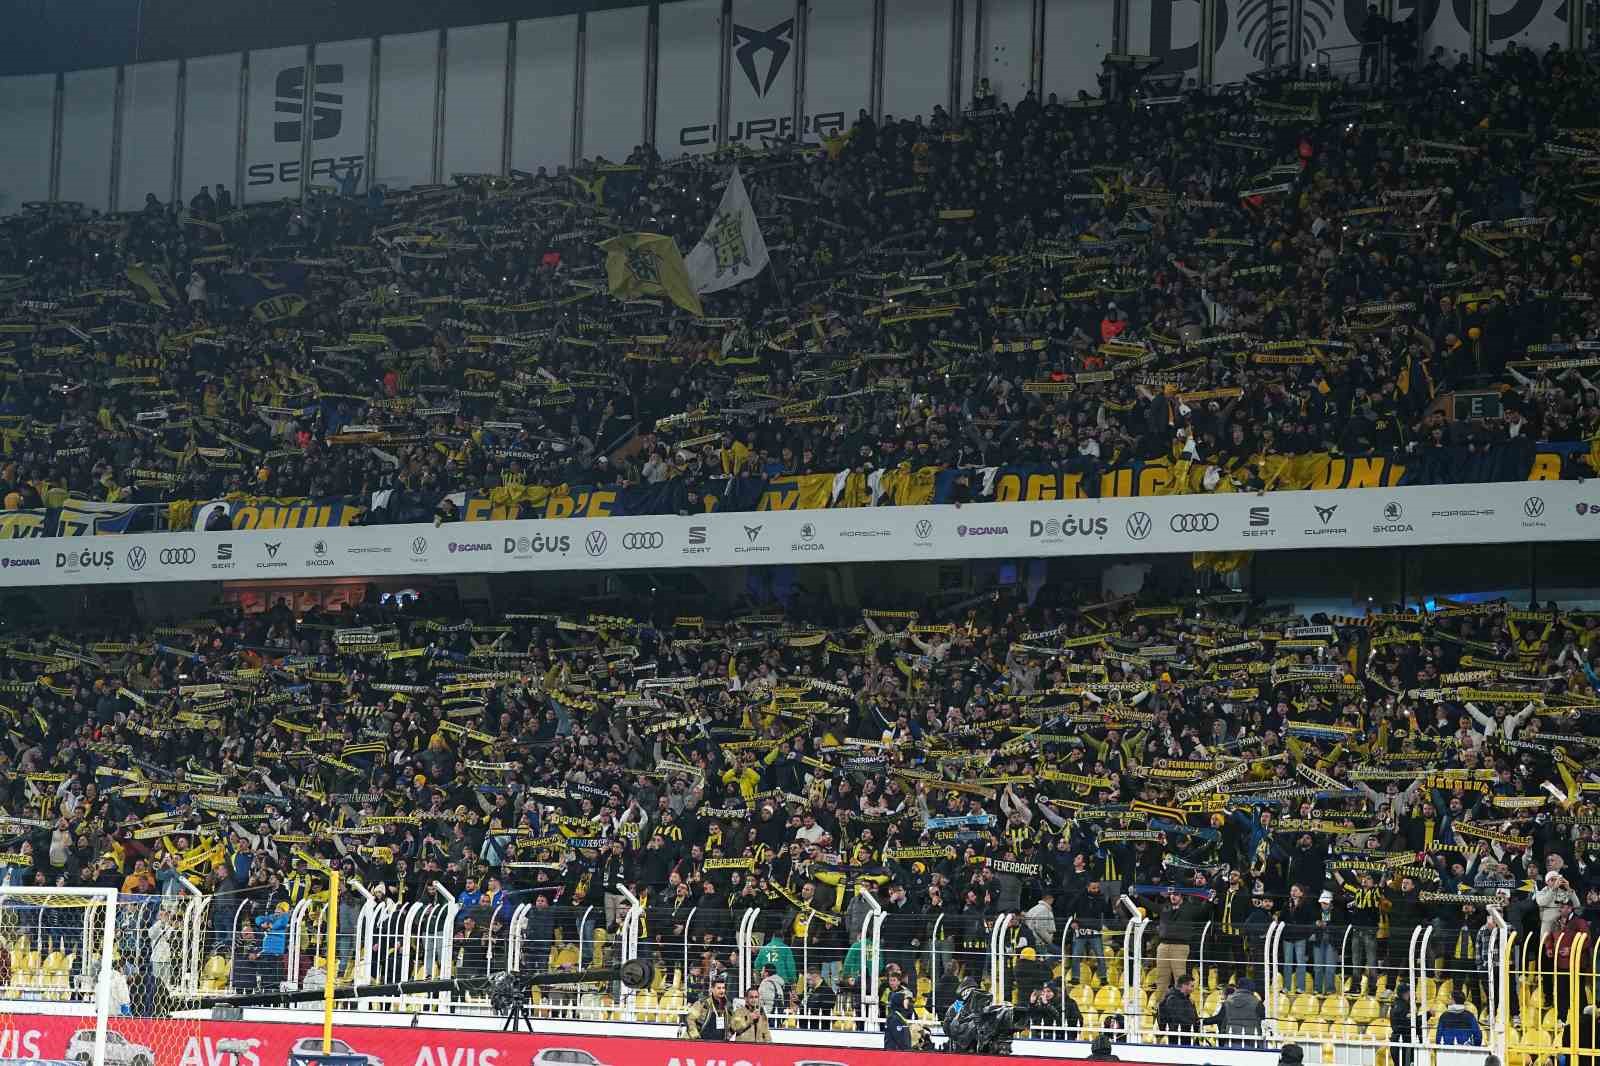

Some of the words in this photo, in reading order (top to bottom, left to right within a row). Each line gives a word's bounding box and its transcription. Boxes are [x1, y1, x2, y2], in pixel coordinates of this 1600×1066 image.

[679, 112, 844, 148] CUPRA
[246, 157, 364, 188] SEAT
[968, 526, 1009, 537] SCANIA
[1242, 529, 1277, 537] SEAT
[1304, 527, 1347, 535] CUPRA
[458, 543, 493, 553] SCANIA
[682, 546, 712, 554] SEAT
[734, 545, 771, 553] CUPRA
[10, 558, 41, 567] SCANIA
[993, 860, 1040, 877] FENERBAHÇE
